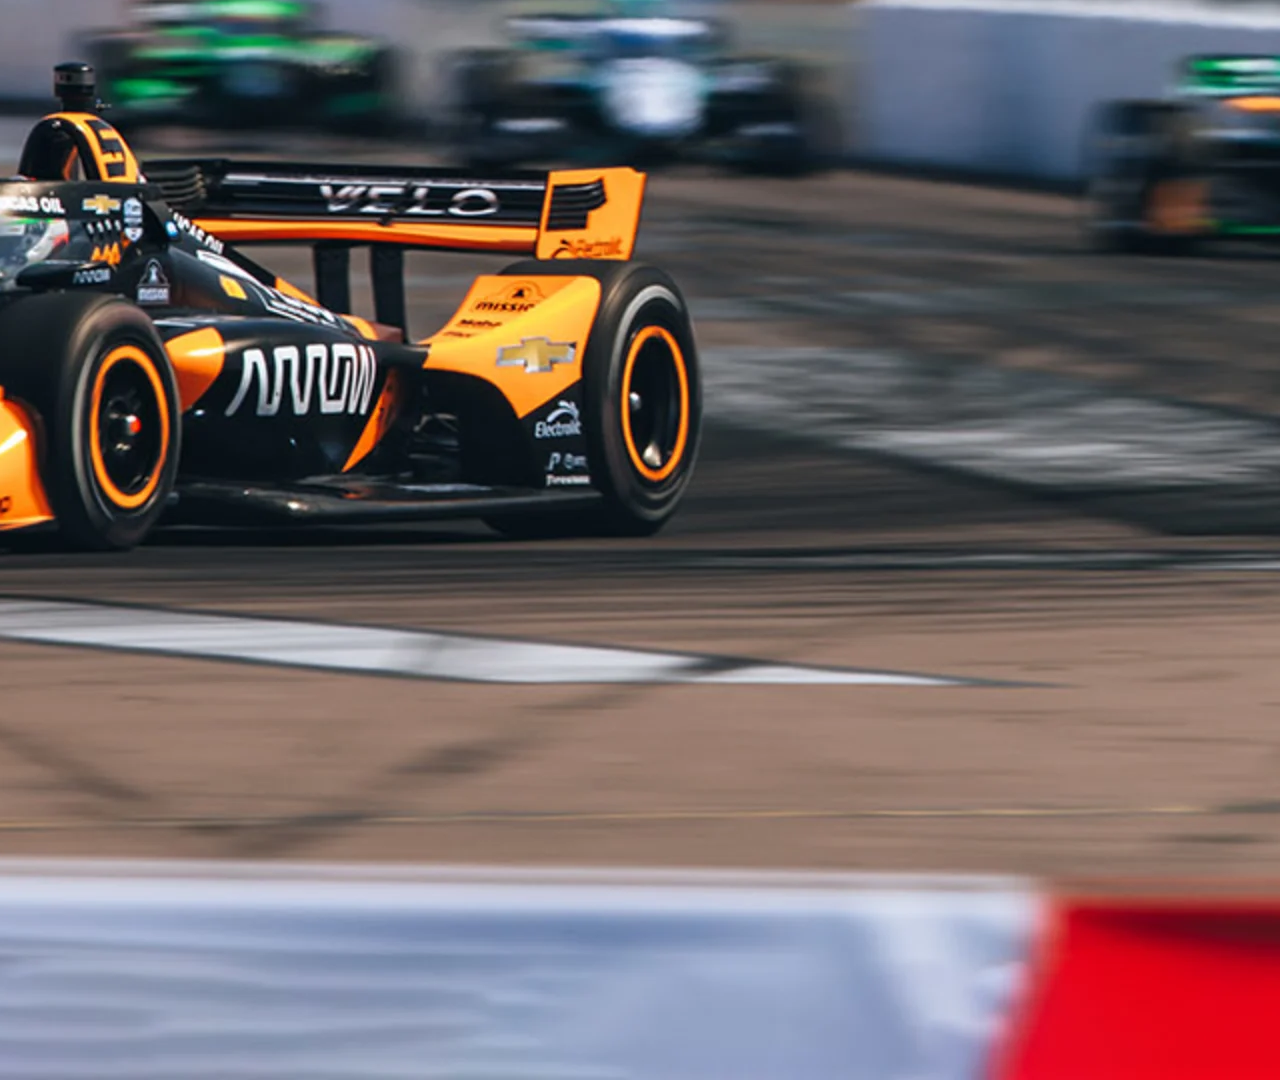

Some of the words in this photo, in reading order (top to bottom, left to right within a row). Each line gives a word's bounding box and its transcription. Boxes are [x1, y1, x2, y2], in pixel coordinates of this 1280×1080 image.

[39, 197, 66, 215] OIL
[320, 183, 499, 216] VELO
[225, 343, 377, 417] ARROW
